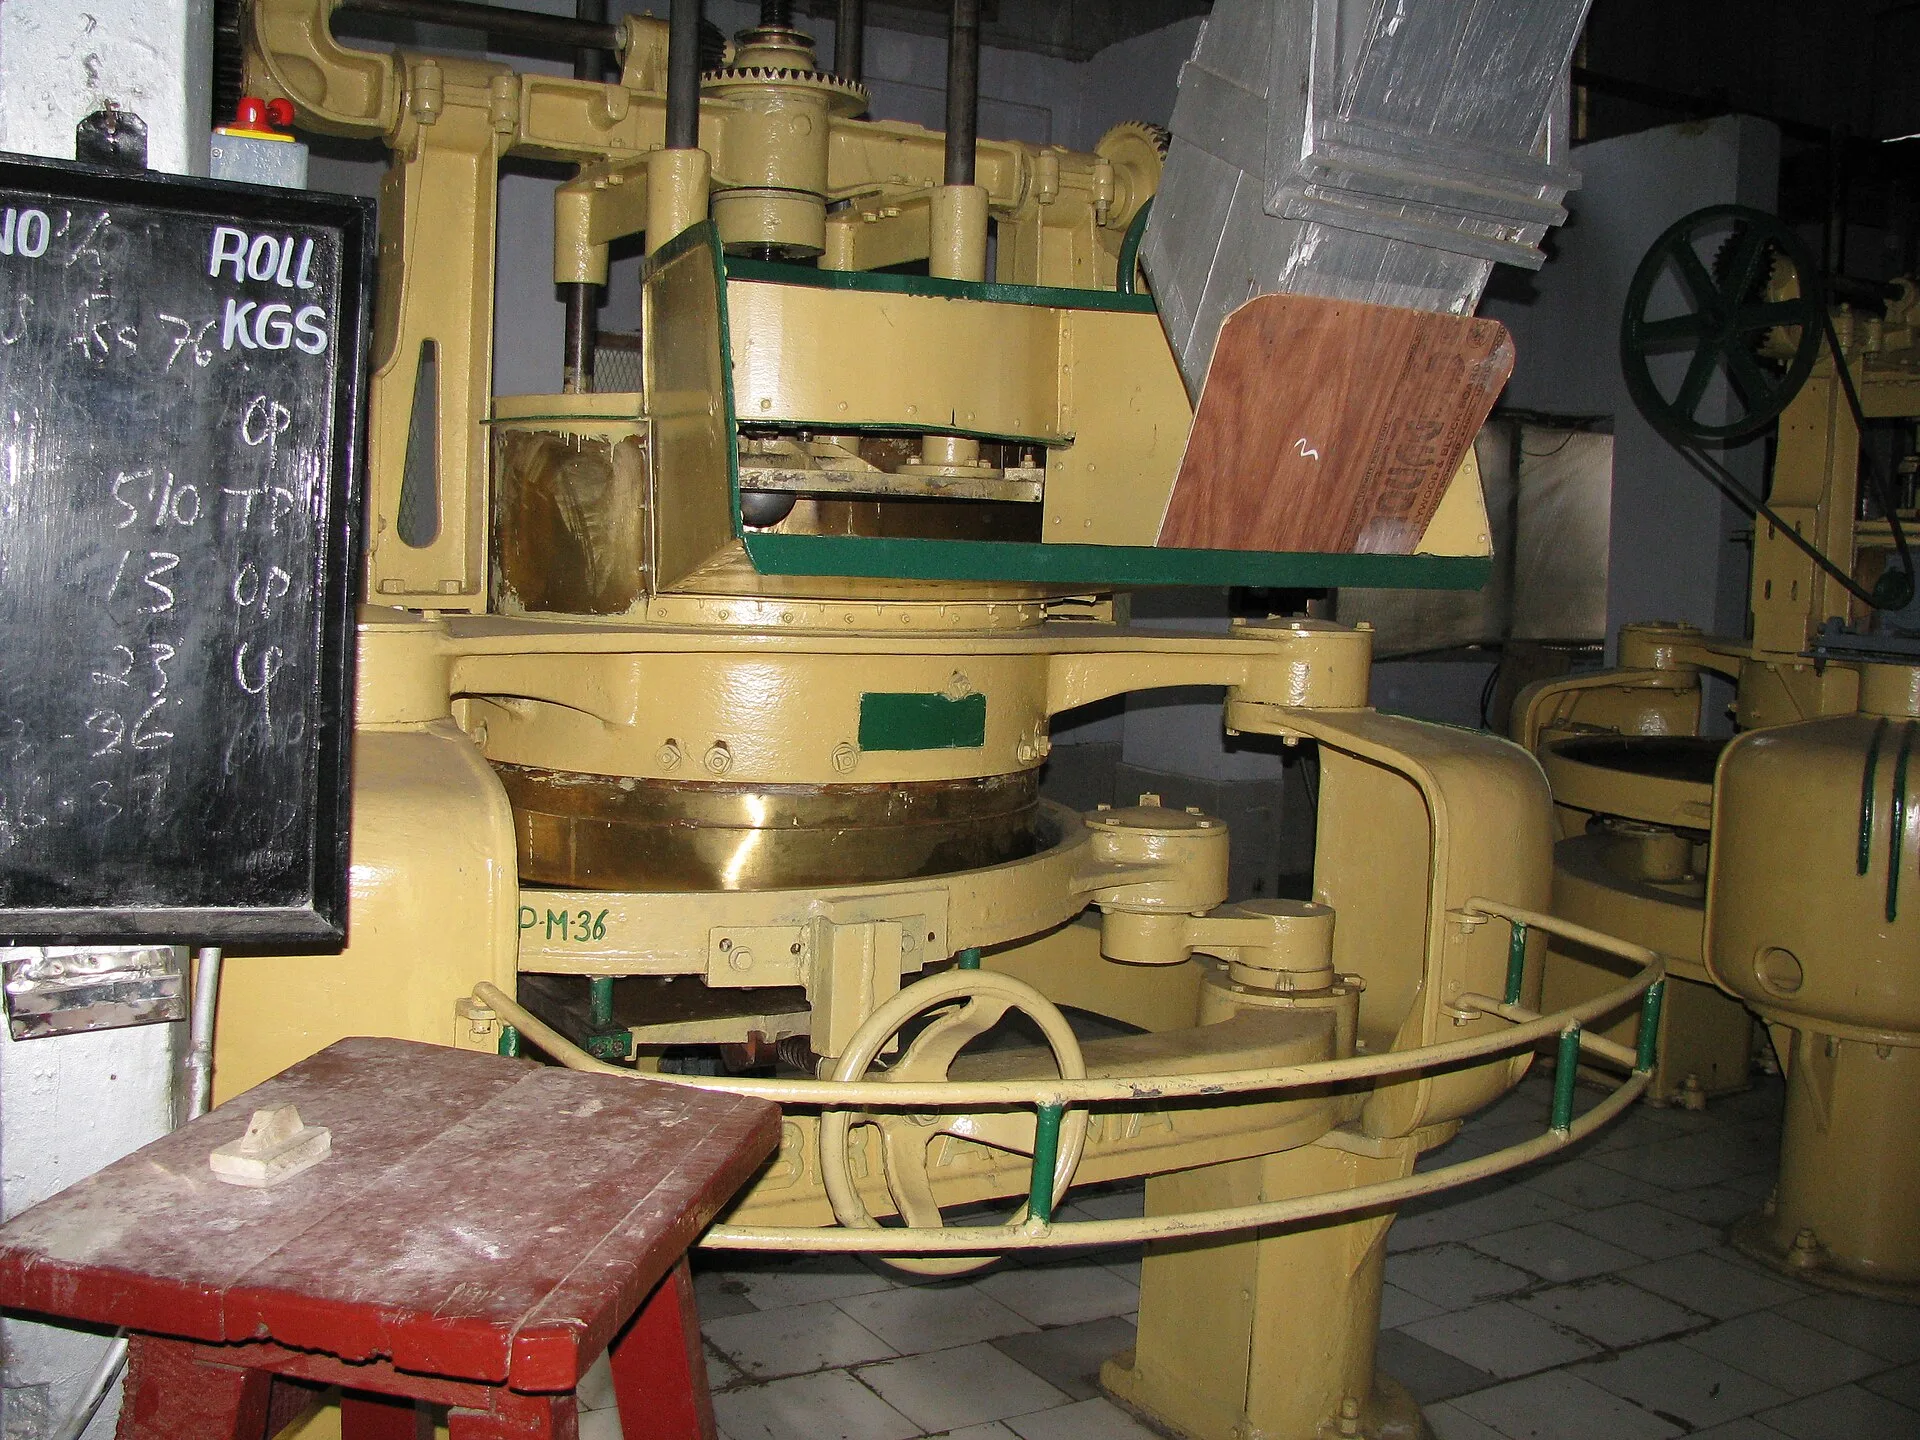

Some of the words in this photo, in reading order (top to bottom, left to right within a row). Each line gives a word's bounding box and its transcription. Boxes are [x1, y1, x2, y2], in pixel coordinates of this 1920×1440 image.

[210, 227, 315, 289] ROLL
[223, 298, 328, 355] KGS
[1440, 411, 1462, 456] BLOCK
[1457, 361, 1481, 409] BOARD
